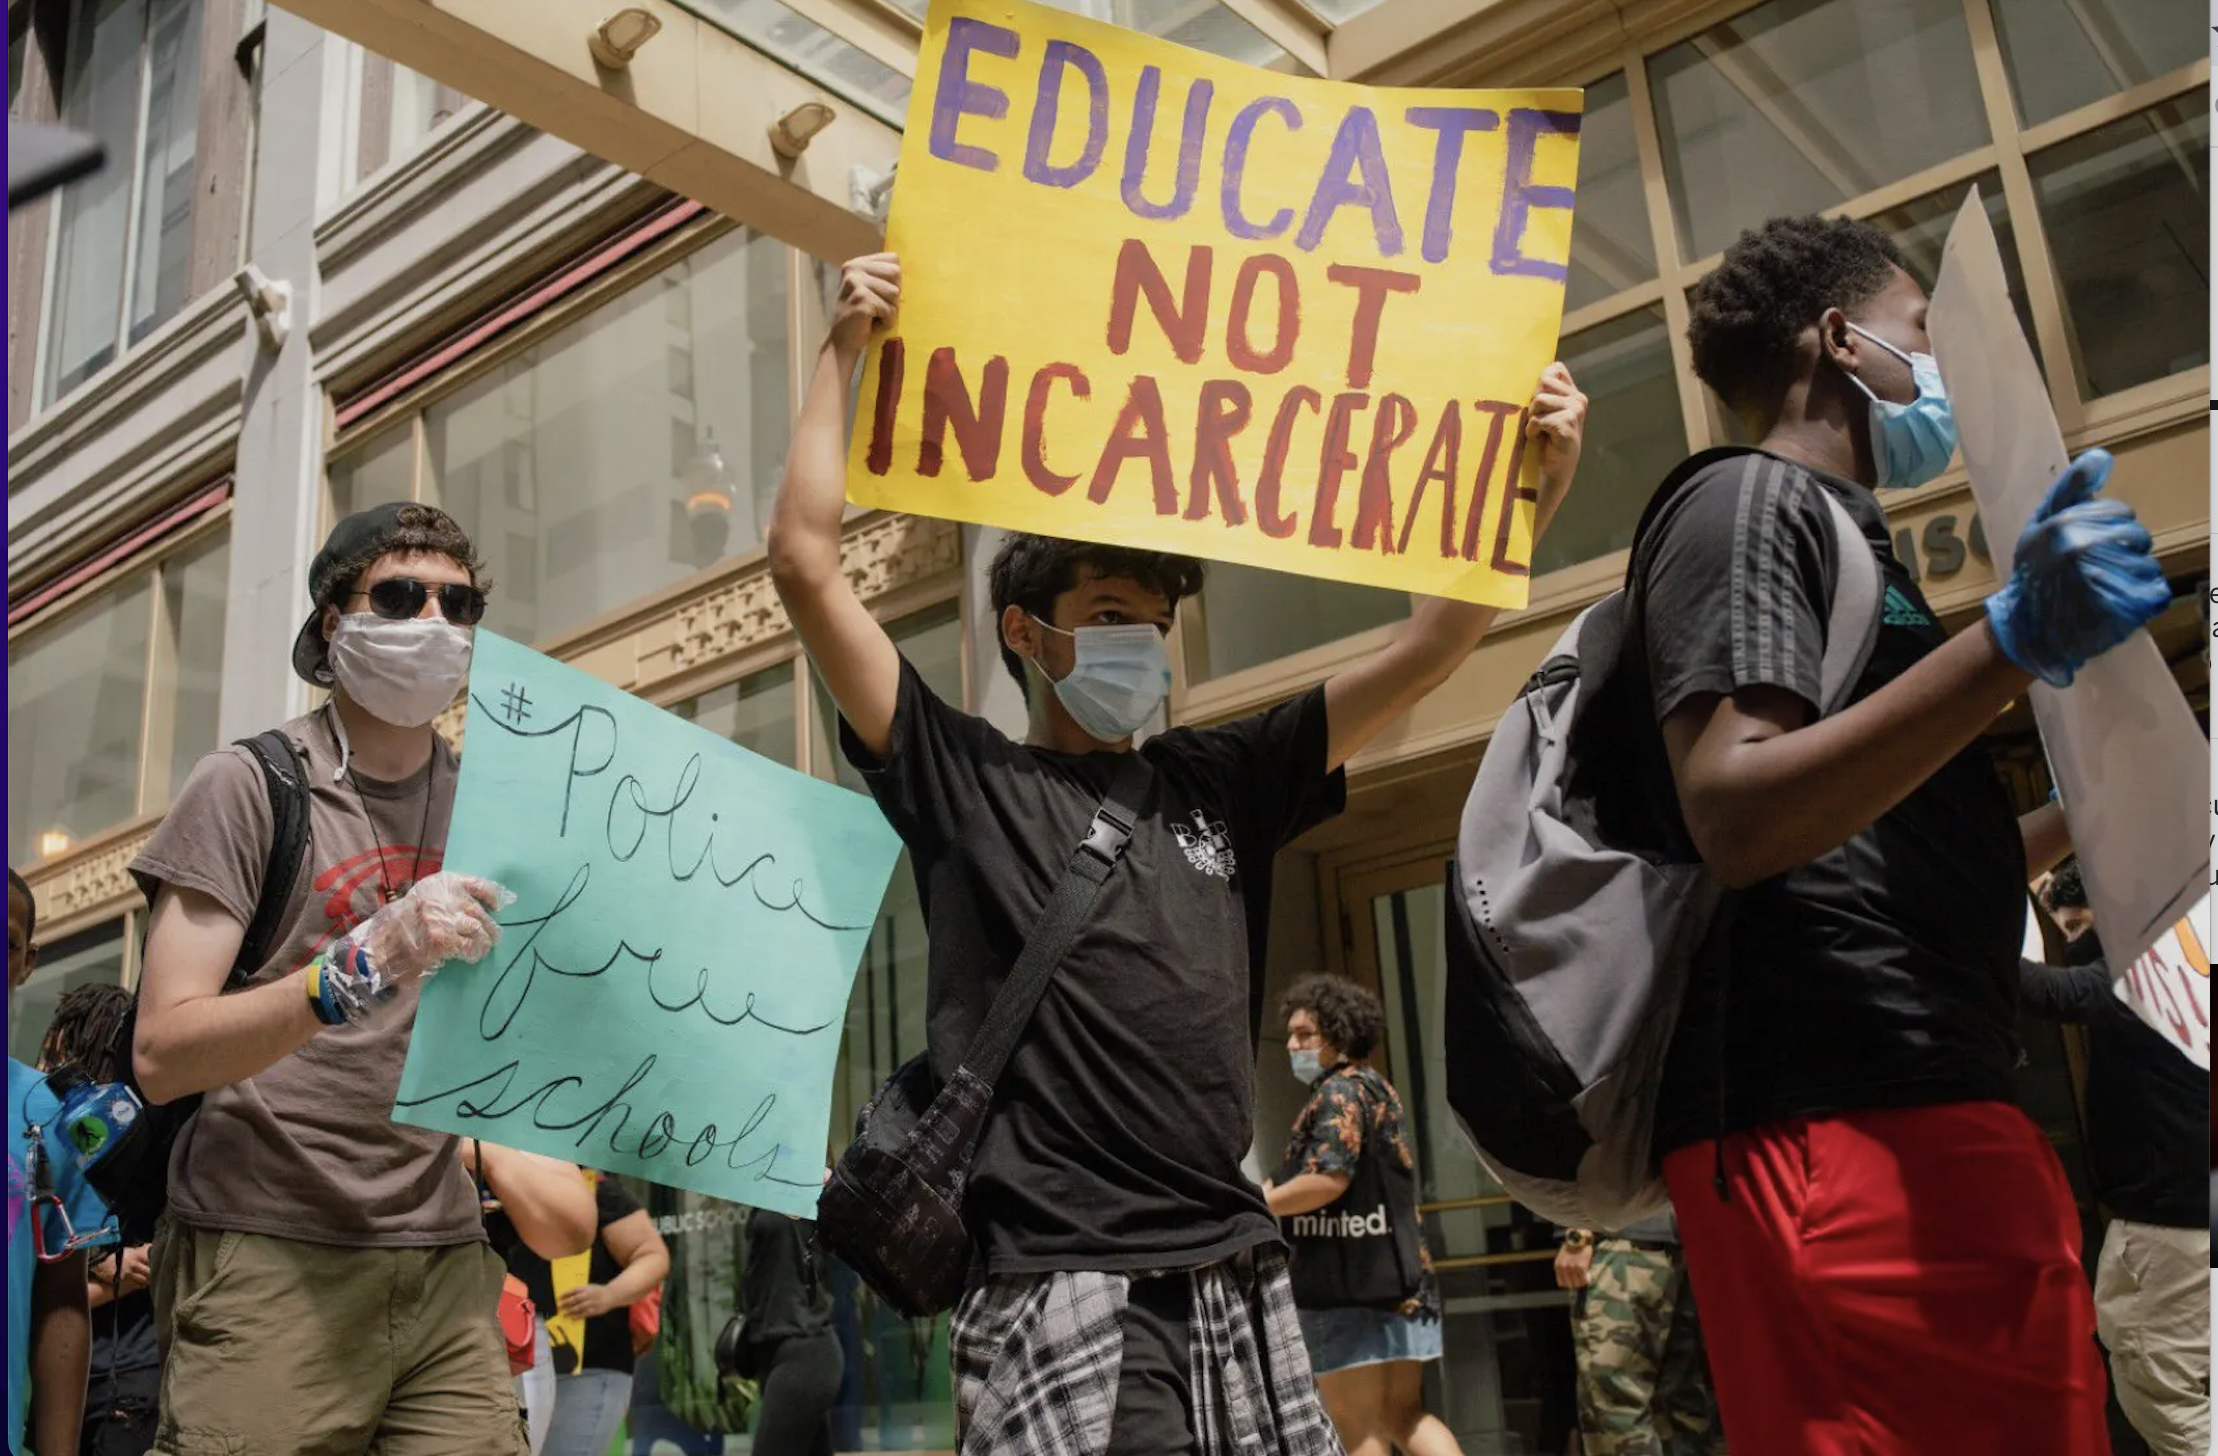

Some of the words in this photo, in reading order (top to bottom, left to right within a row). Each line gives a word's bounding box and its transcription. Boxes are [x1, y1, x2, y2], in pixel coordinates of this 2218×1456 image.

[929, 16, 1582, 283] EDUCATE
[1107, 238, 1421, 389] NOT
[868, 338, 1537, 577] INCARCERATE
[480, 863, 841, 1041] free
[395, 1054, 826, 1187] schools
